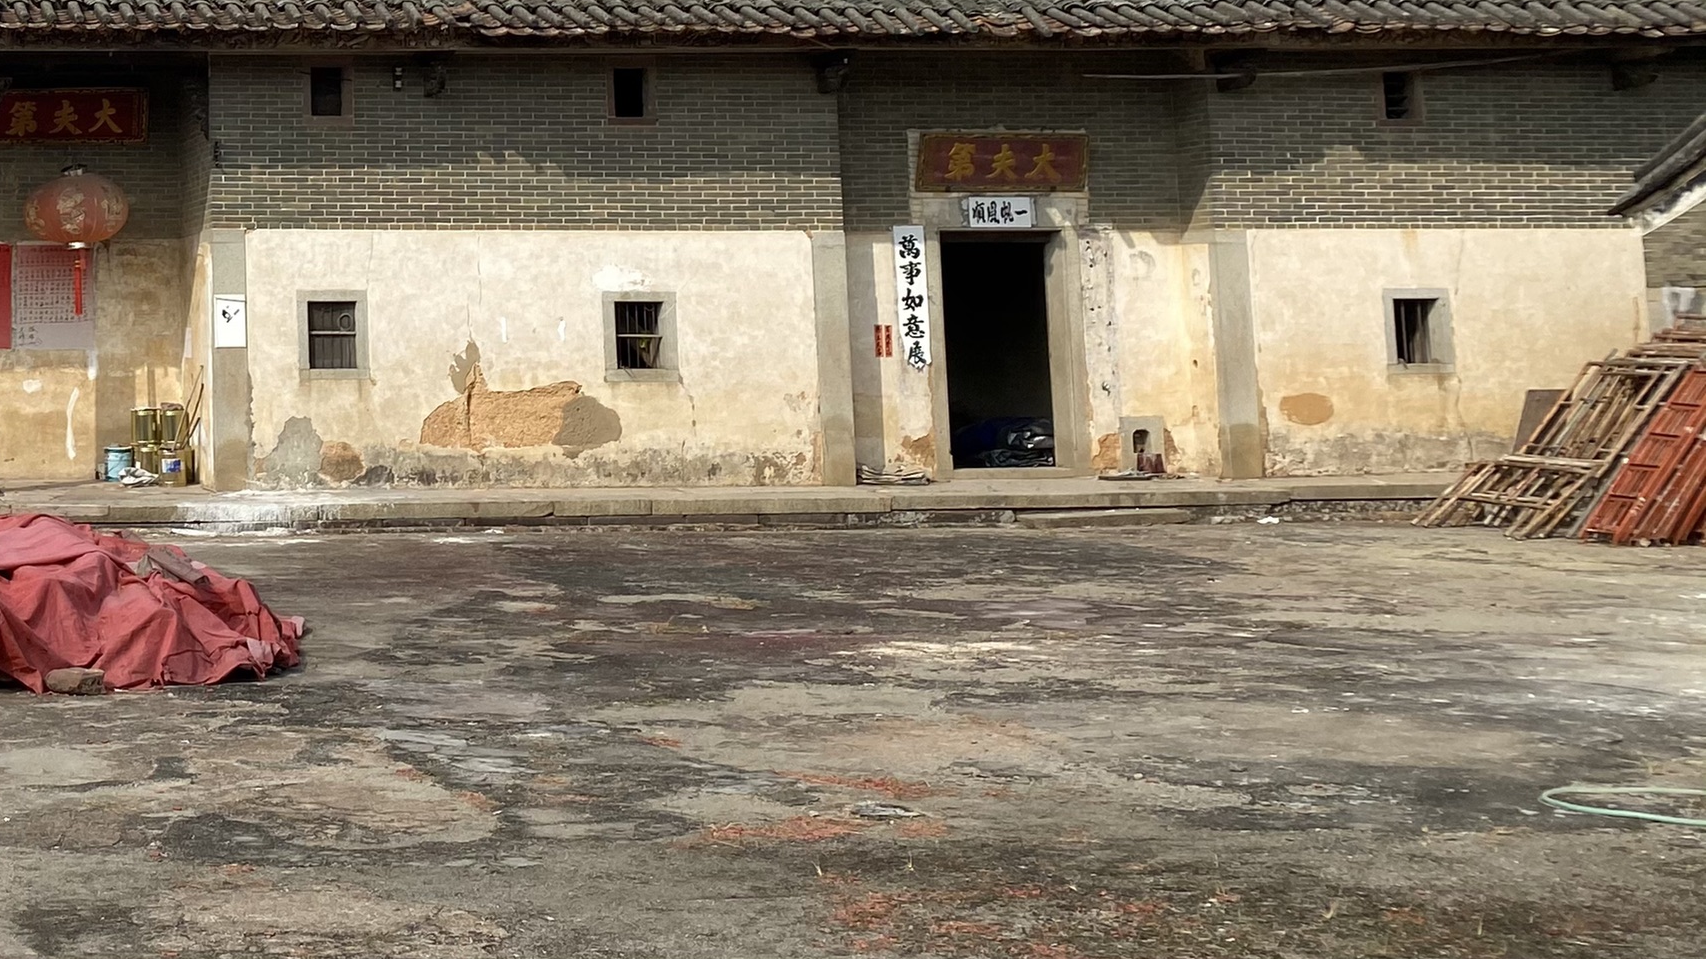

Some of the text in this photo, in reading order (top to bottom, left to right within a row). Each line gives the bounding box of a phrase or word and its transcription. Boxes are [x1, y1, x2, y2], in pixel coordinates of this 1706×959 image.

[6, 98, 124, 138] 大夫第
[945, 142, 1062, 182] 大夫第
